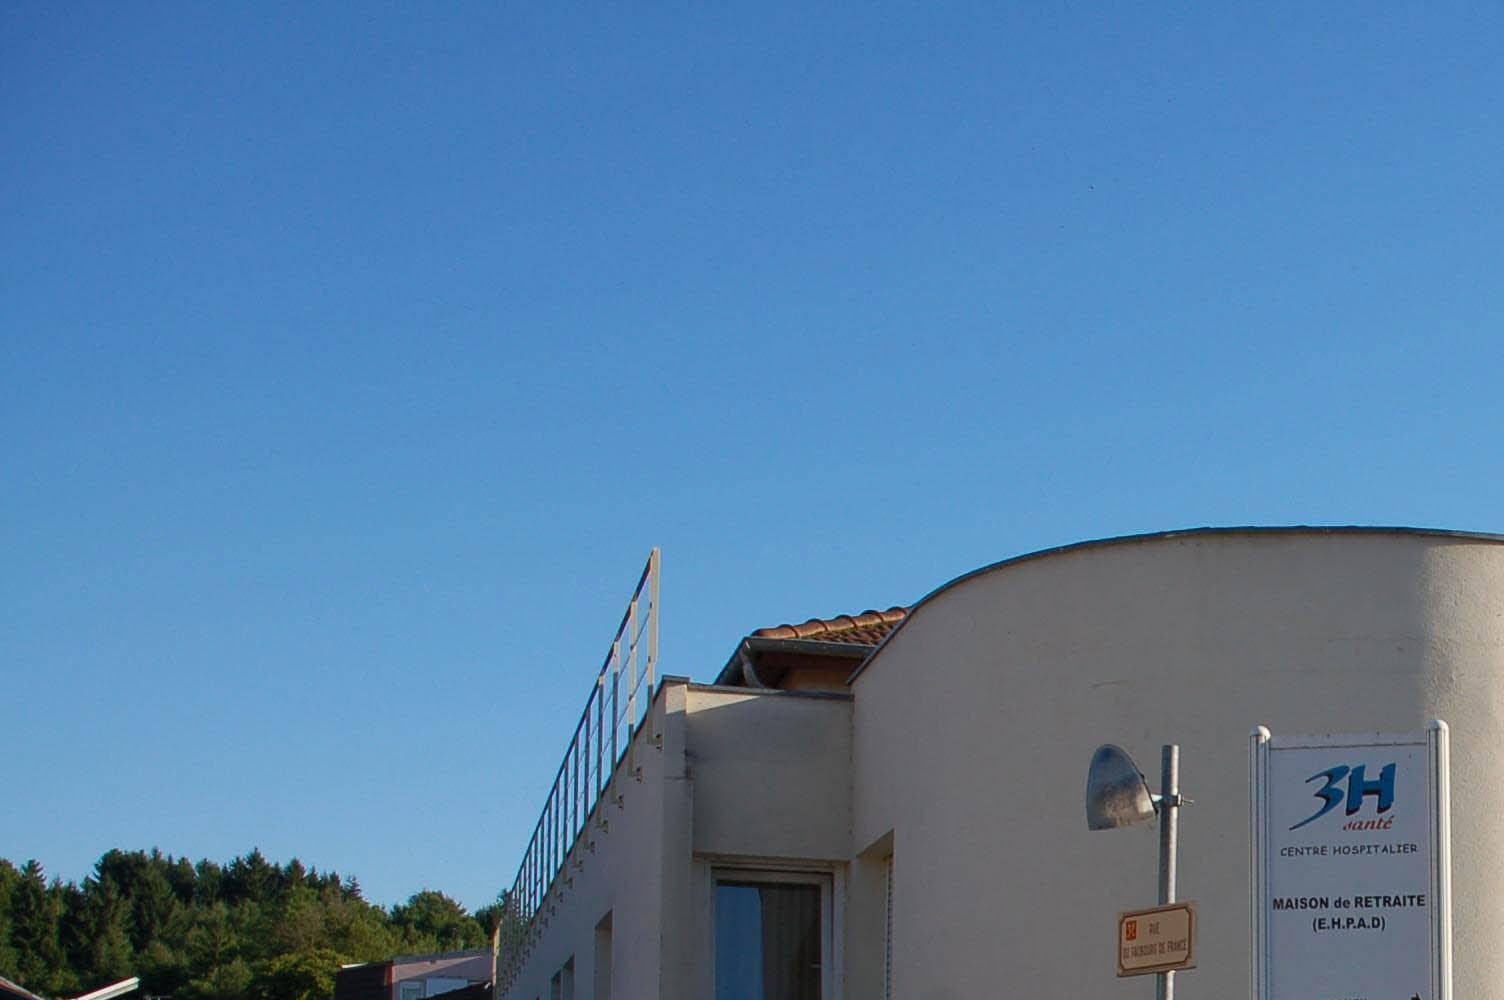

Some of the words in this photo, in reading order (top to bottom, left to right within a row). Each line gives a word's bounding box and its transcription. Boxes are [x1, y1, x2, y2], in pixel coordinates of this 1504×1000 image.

[1289, 763, 1397, 831] 3H
[1343, 815, 1395, 831] santé
[1280, 846, 1328, 857] CENTRE
[1333, 843, 1418, 855] HOSPITALIER
[1272, 897, 1329, 910] MAISON
[1334, 896, 1350, 909] de
[1354, 894, 1426, 908] RETRAITE
[1312, 916, 1386, 932] (E.H.P.A.D)
